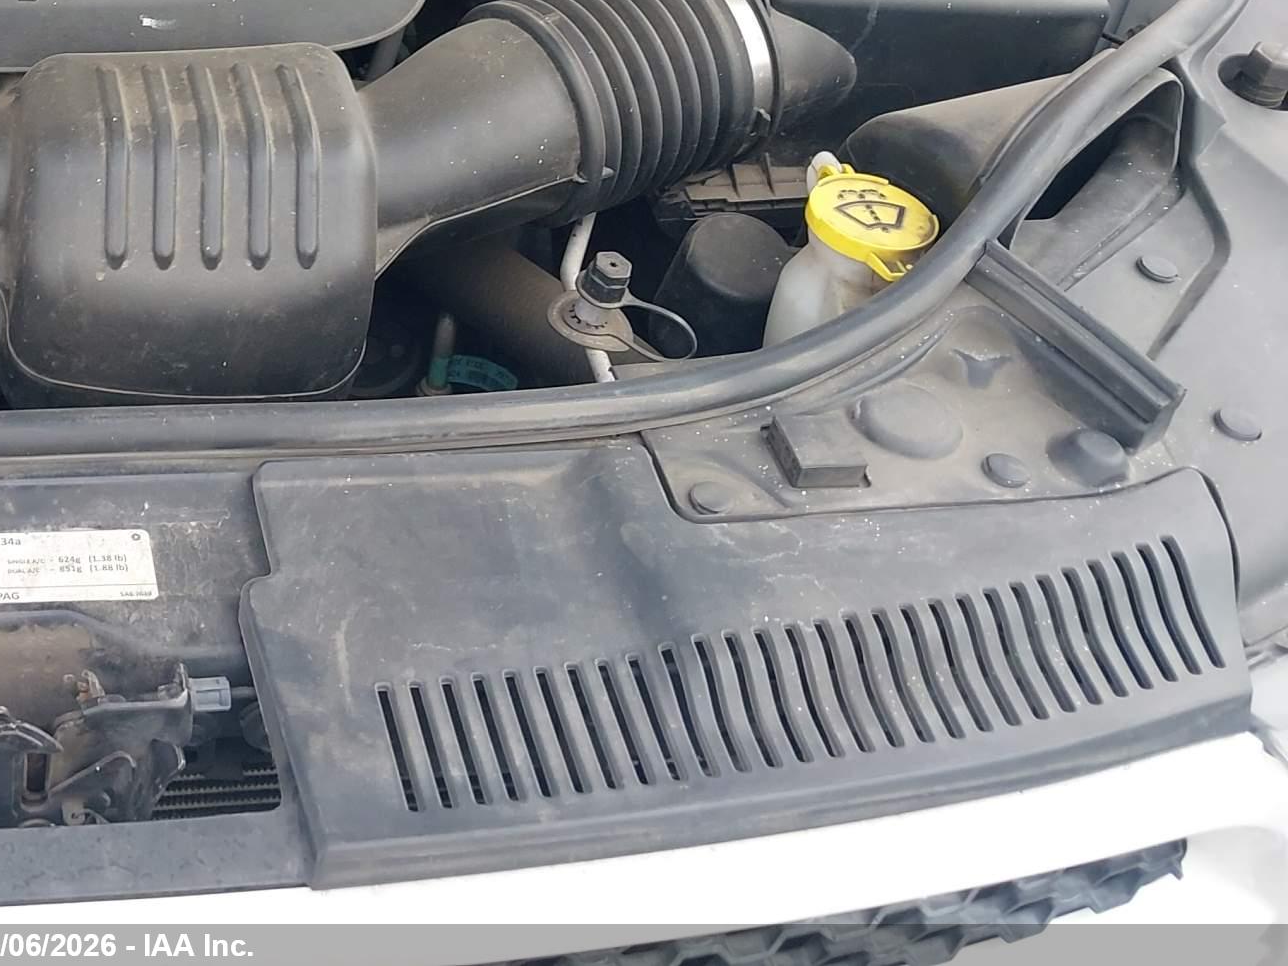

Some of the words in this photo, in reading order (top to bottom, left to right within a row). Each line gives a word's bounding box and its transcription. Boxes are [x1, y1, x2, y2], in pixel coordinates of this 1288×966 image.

[58, 555, 81, 565] 624g
[114, 553, 128, 563] lb)
[115, 563, 129, 572] lb)
